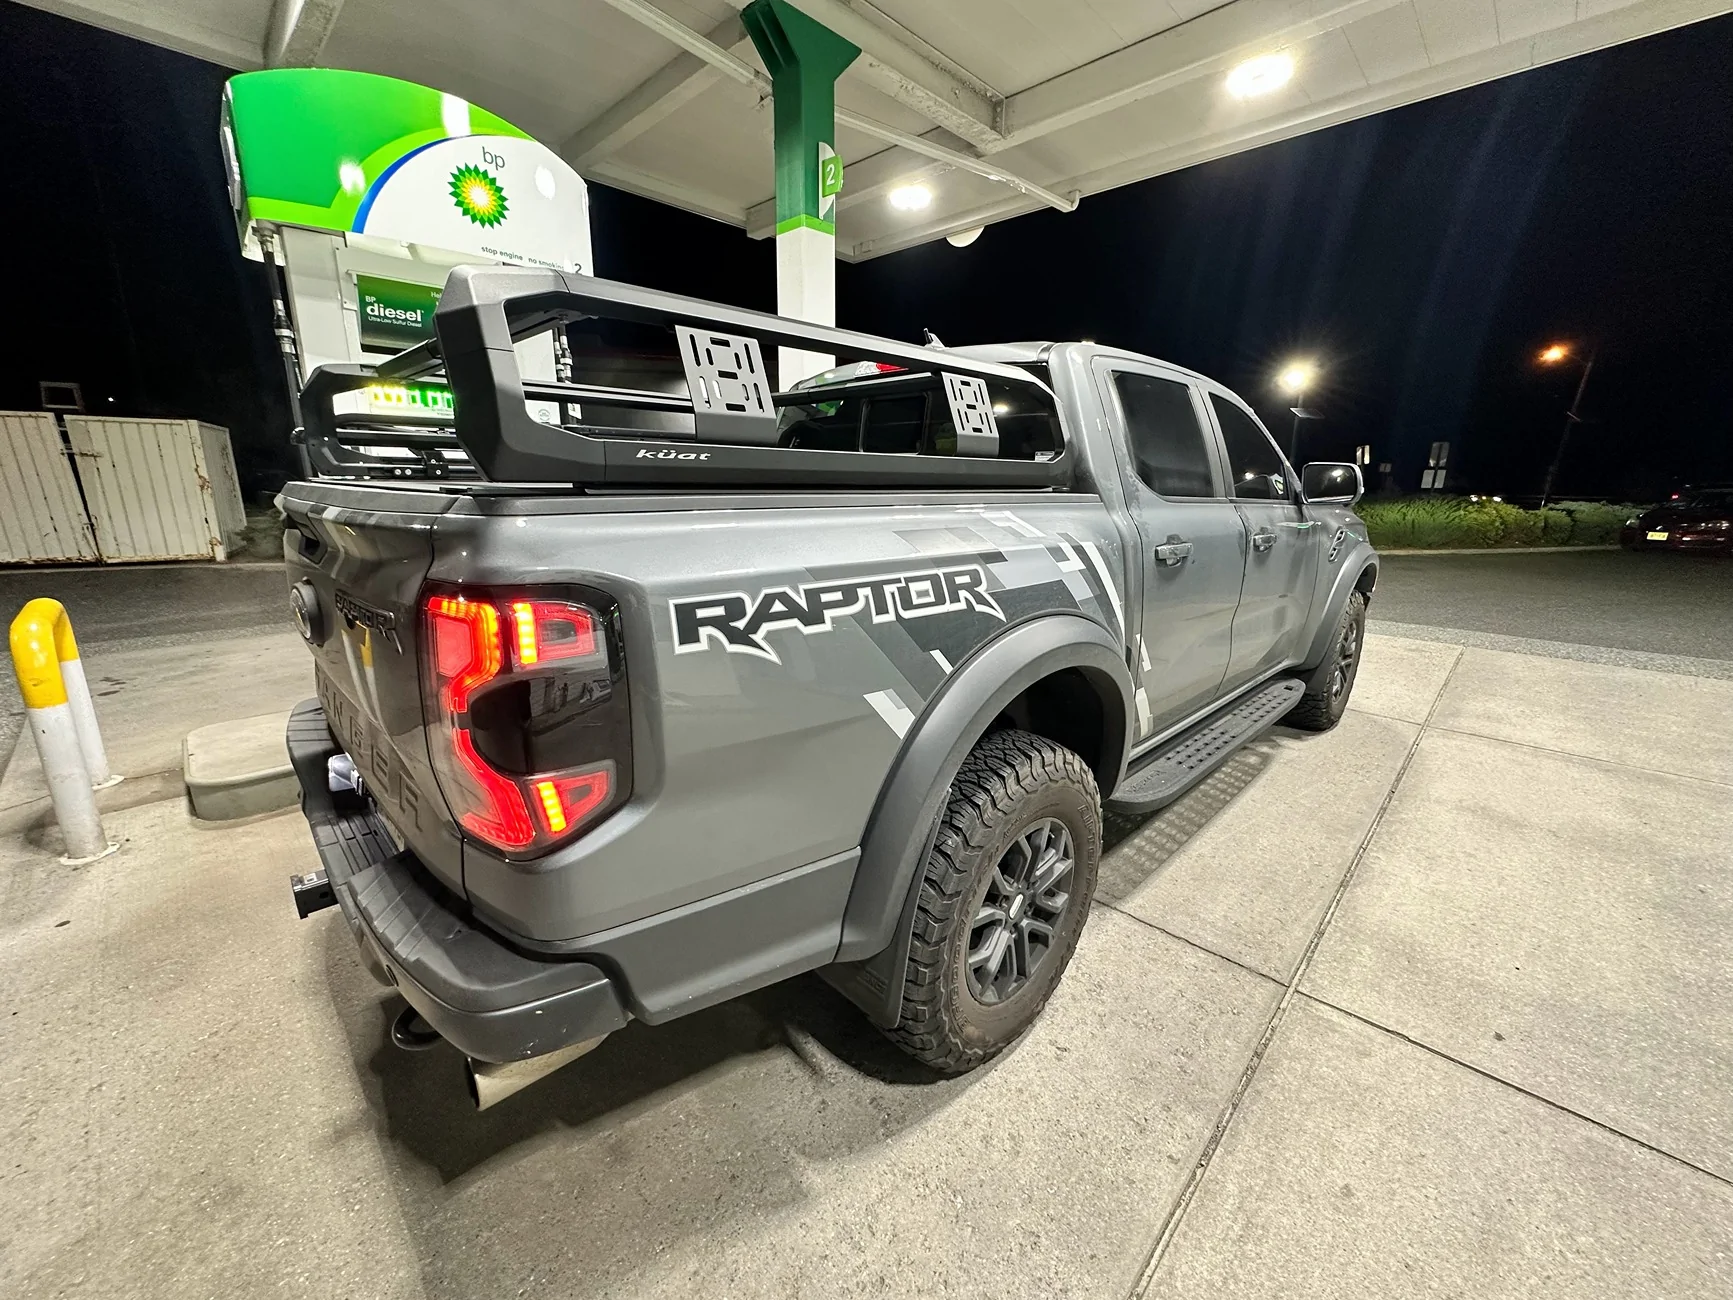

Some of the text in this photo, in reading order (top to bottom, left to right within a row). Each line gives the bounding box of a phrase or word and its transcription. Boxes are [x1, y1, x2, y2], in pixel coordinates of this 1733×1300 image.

[482, 146, 505, 171] bp
[826, 164, 835, 186] 2
[481, 246, 498, 256] stop
[499, 250, 523, 261] engine
[574, 263, 582, 274] 2
[365, 295, 376, 303] BP
[366, 303, 422, 322] diesel
[635, 449, 711, 460] küat
[668, 563, 1007, 666] RAPTOR
